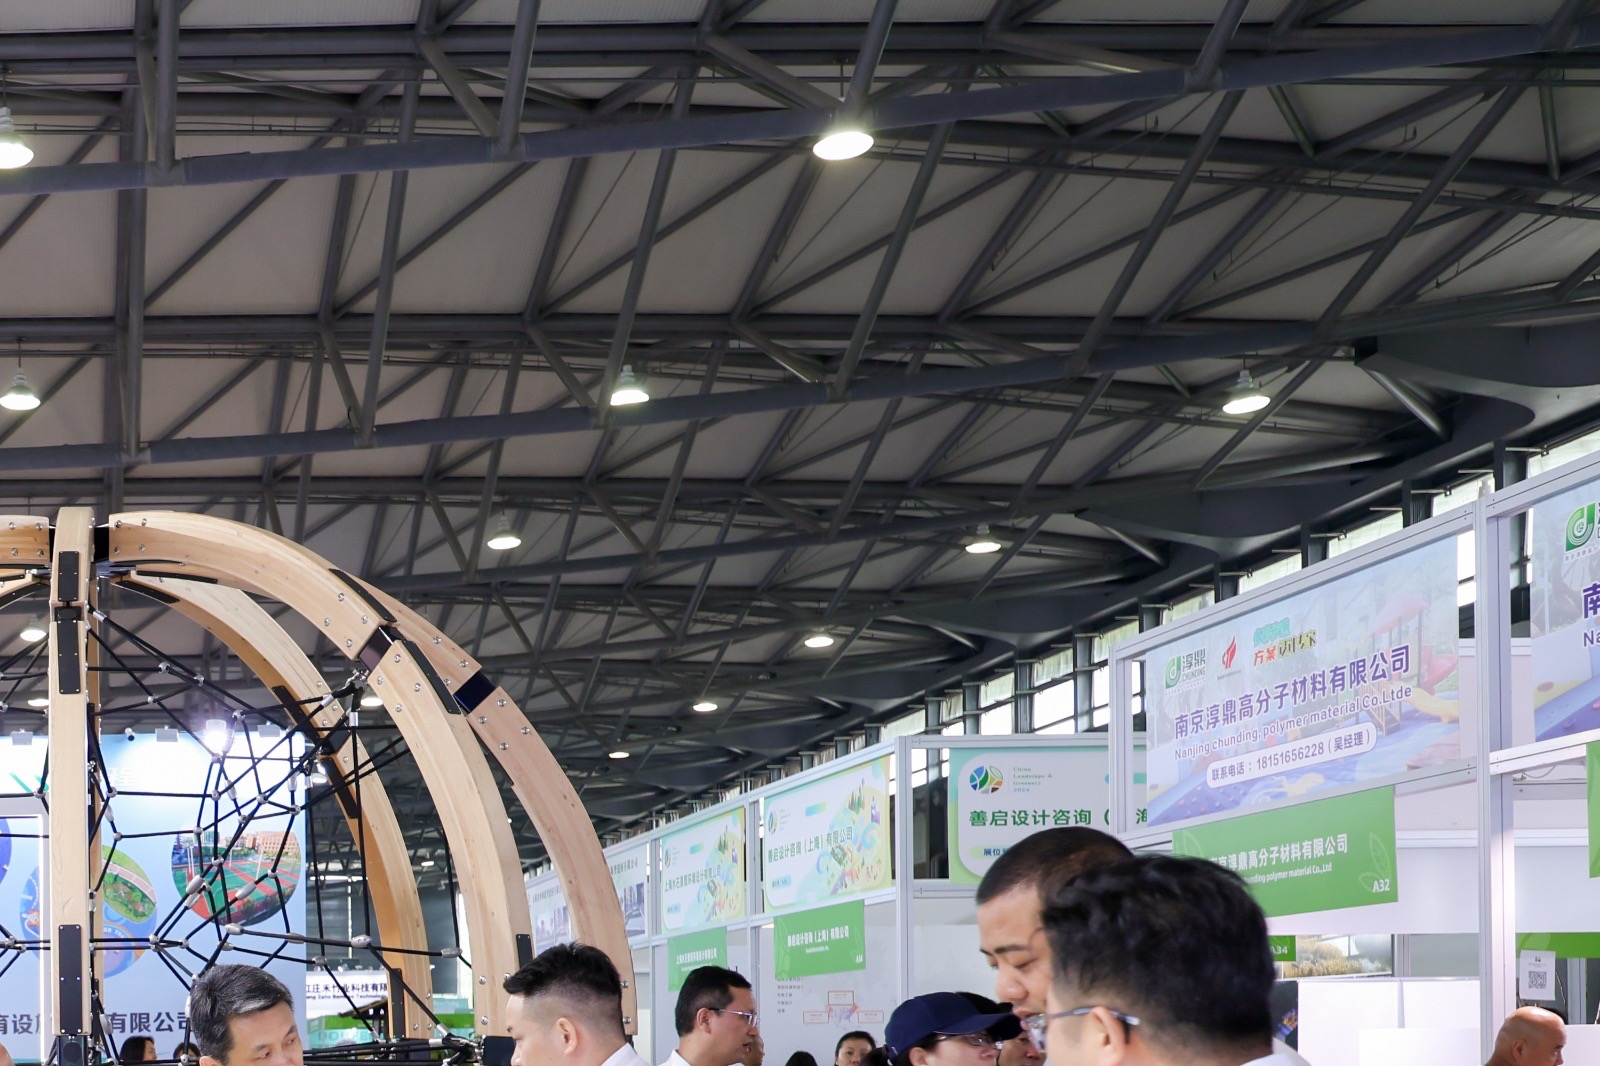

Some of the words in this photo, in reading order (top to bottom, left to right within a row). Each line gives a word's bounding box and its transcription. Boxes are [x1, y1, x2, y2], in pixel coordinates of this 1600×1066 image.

[1174, 644, 1410, 740] 南京淳鼎高分子材料有限公司
[1373, 879, 1390, 893] A32
